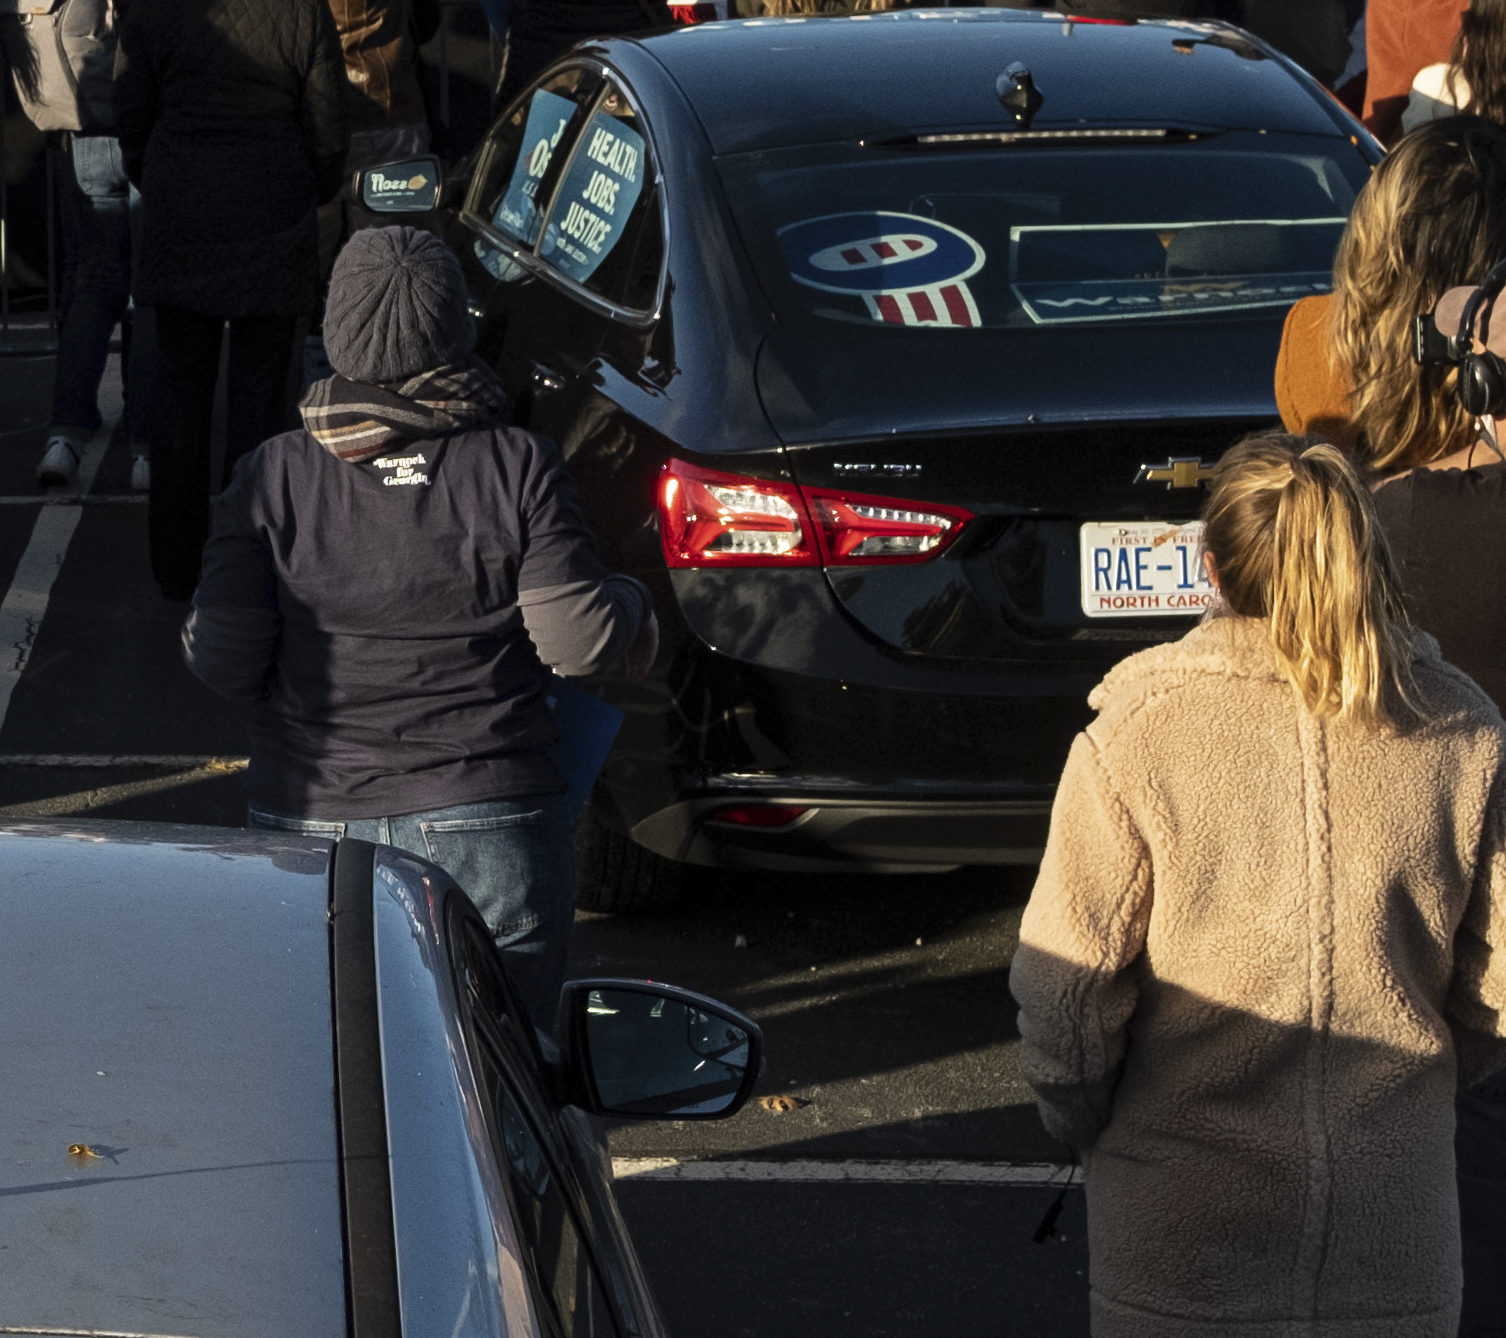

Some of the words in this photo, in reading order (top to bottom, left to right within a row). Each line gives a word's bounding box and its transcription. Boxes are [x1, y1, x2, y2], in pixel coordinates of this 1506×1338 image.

[373, 453, 426, 469] Warnock
[396, 467, 415, 477] for
[1111, 536, 1148, 546] FIRST
[1099, 595, 1159, 609] NORTH
[1166, 594, 1214, 609] CARO
